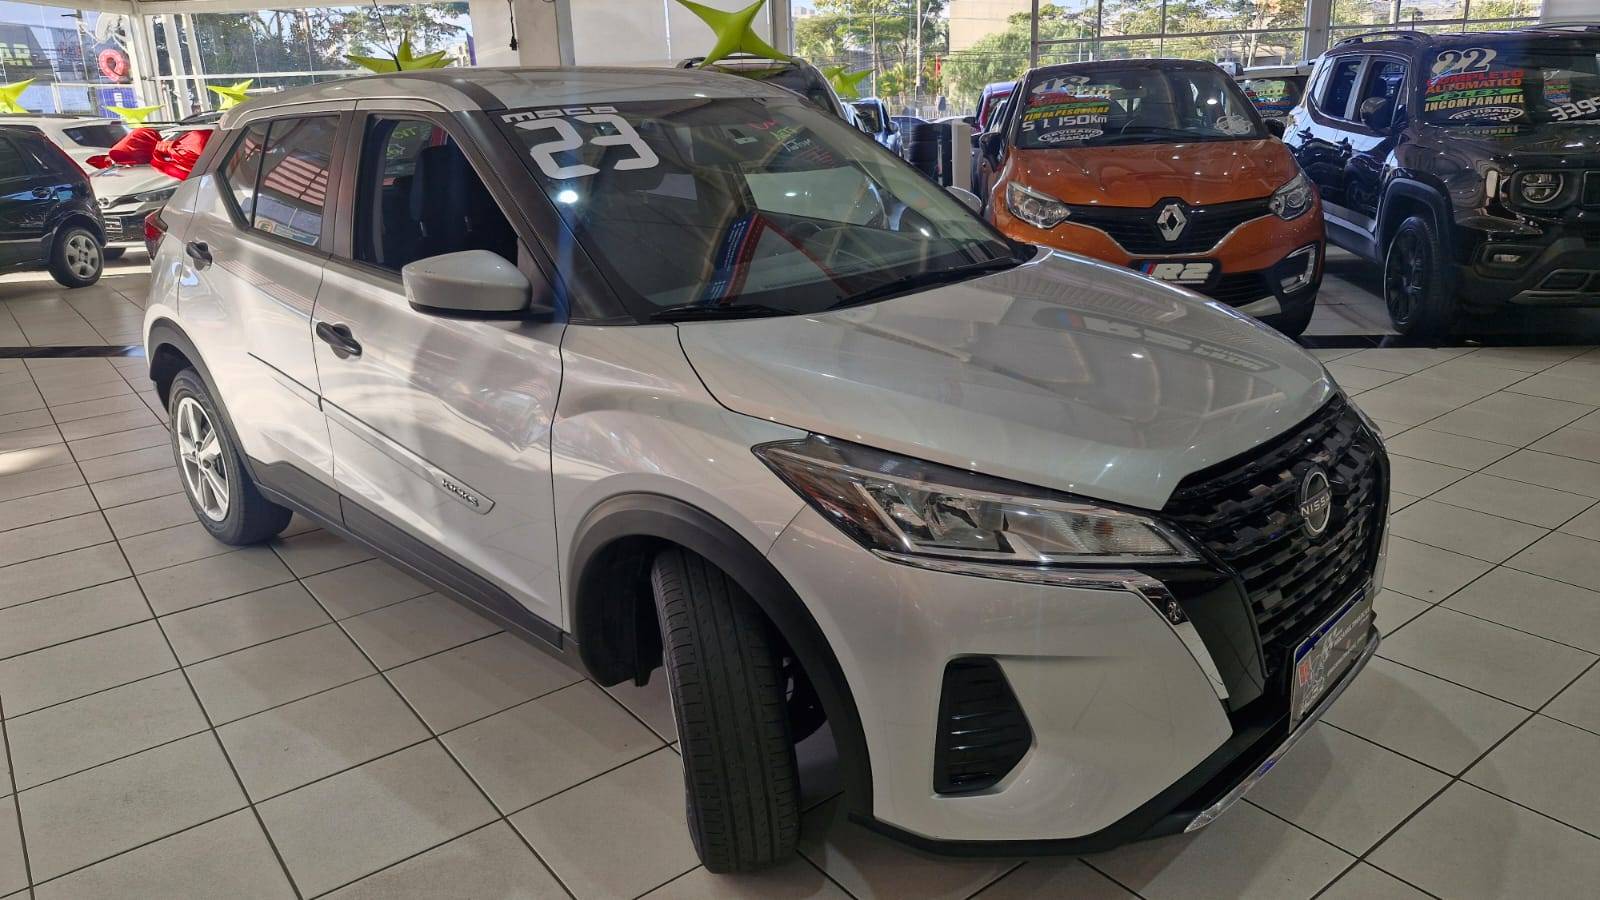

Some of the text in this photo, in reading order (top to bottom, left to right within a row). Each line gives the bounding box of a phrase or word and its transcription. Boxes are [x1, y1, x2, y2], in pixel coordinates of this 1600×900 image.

[1432, 47, 1497, 75] 22
[1425, 78, 1522, 95] AUTOMATICO
[1424, 94, 1524, 112] INCOMPARAVEL
[514, 113, 660, 180] 23
